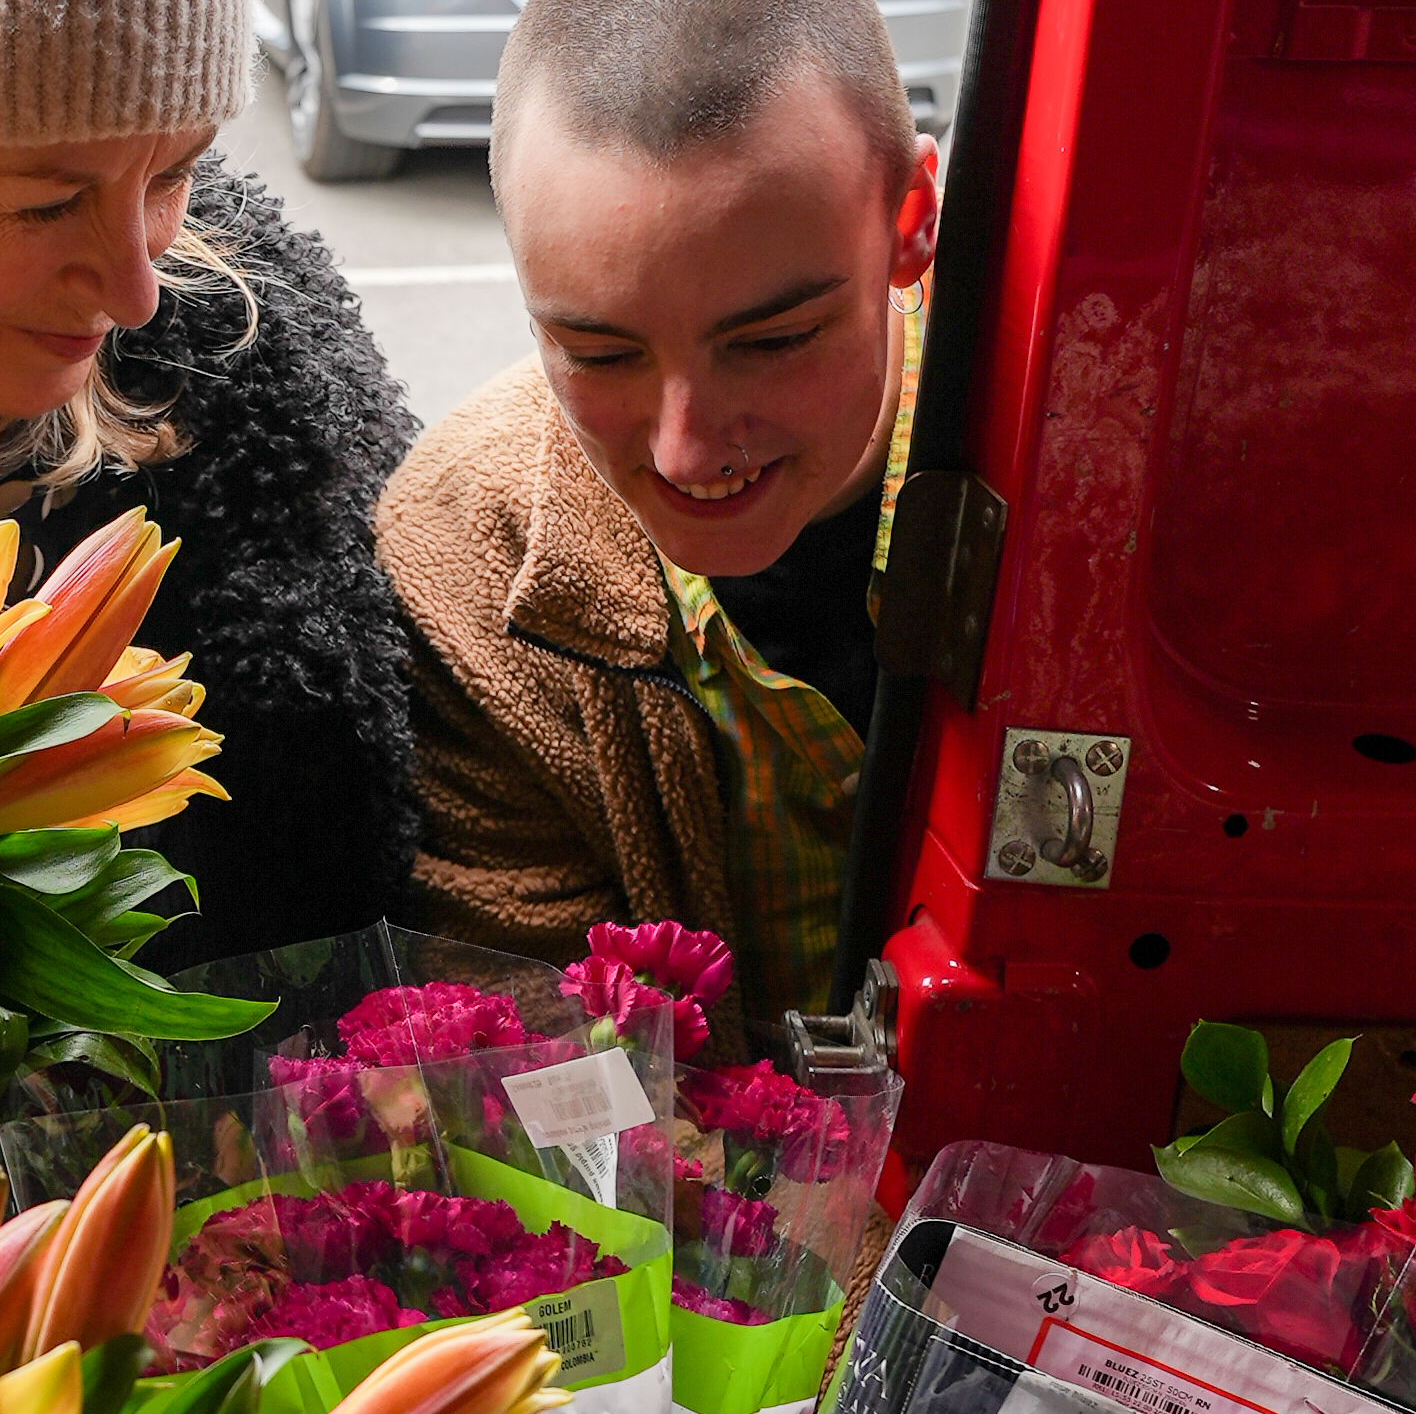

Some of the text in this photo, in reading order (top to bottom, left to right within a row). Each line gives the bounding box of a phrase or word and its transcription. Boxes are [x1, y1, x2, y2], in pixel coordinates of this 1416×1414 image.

[538, 1299, 572, 1318] GOLEM
[1036, 1282, 1075, 1314] 22
[560, 1351, 596, 1372] COLOMBIA
[1104, 1359, 1140, 1379] BLUEZ
[1194, 1398, 1212, 1411] RN
